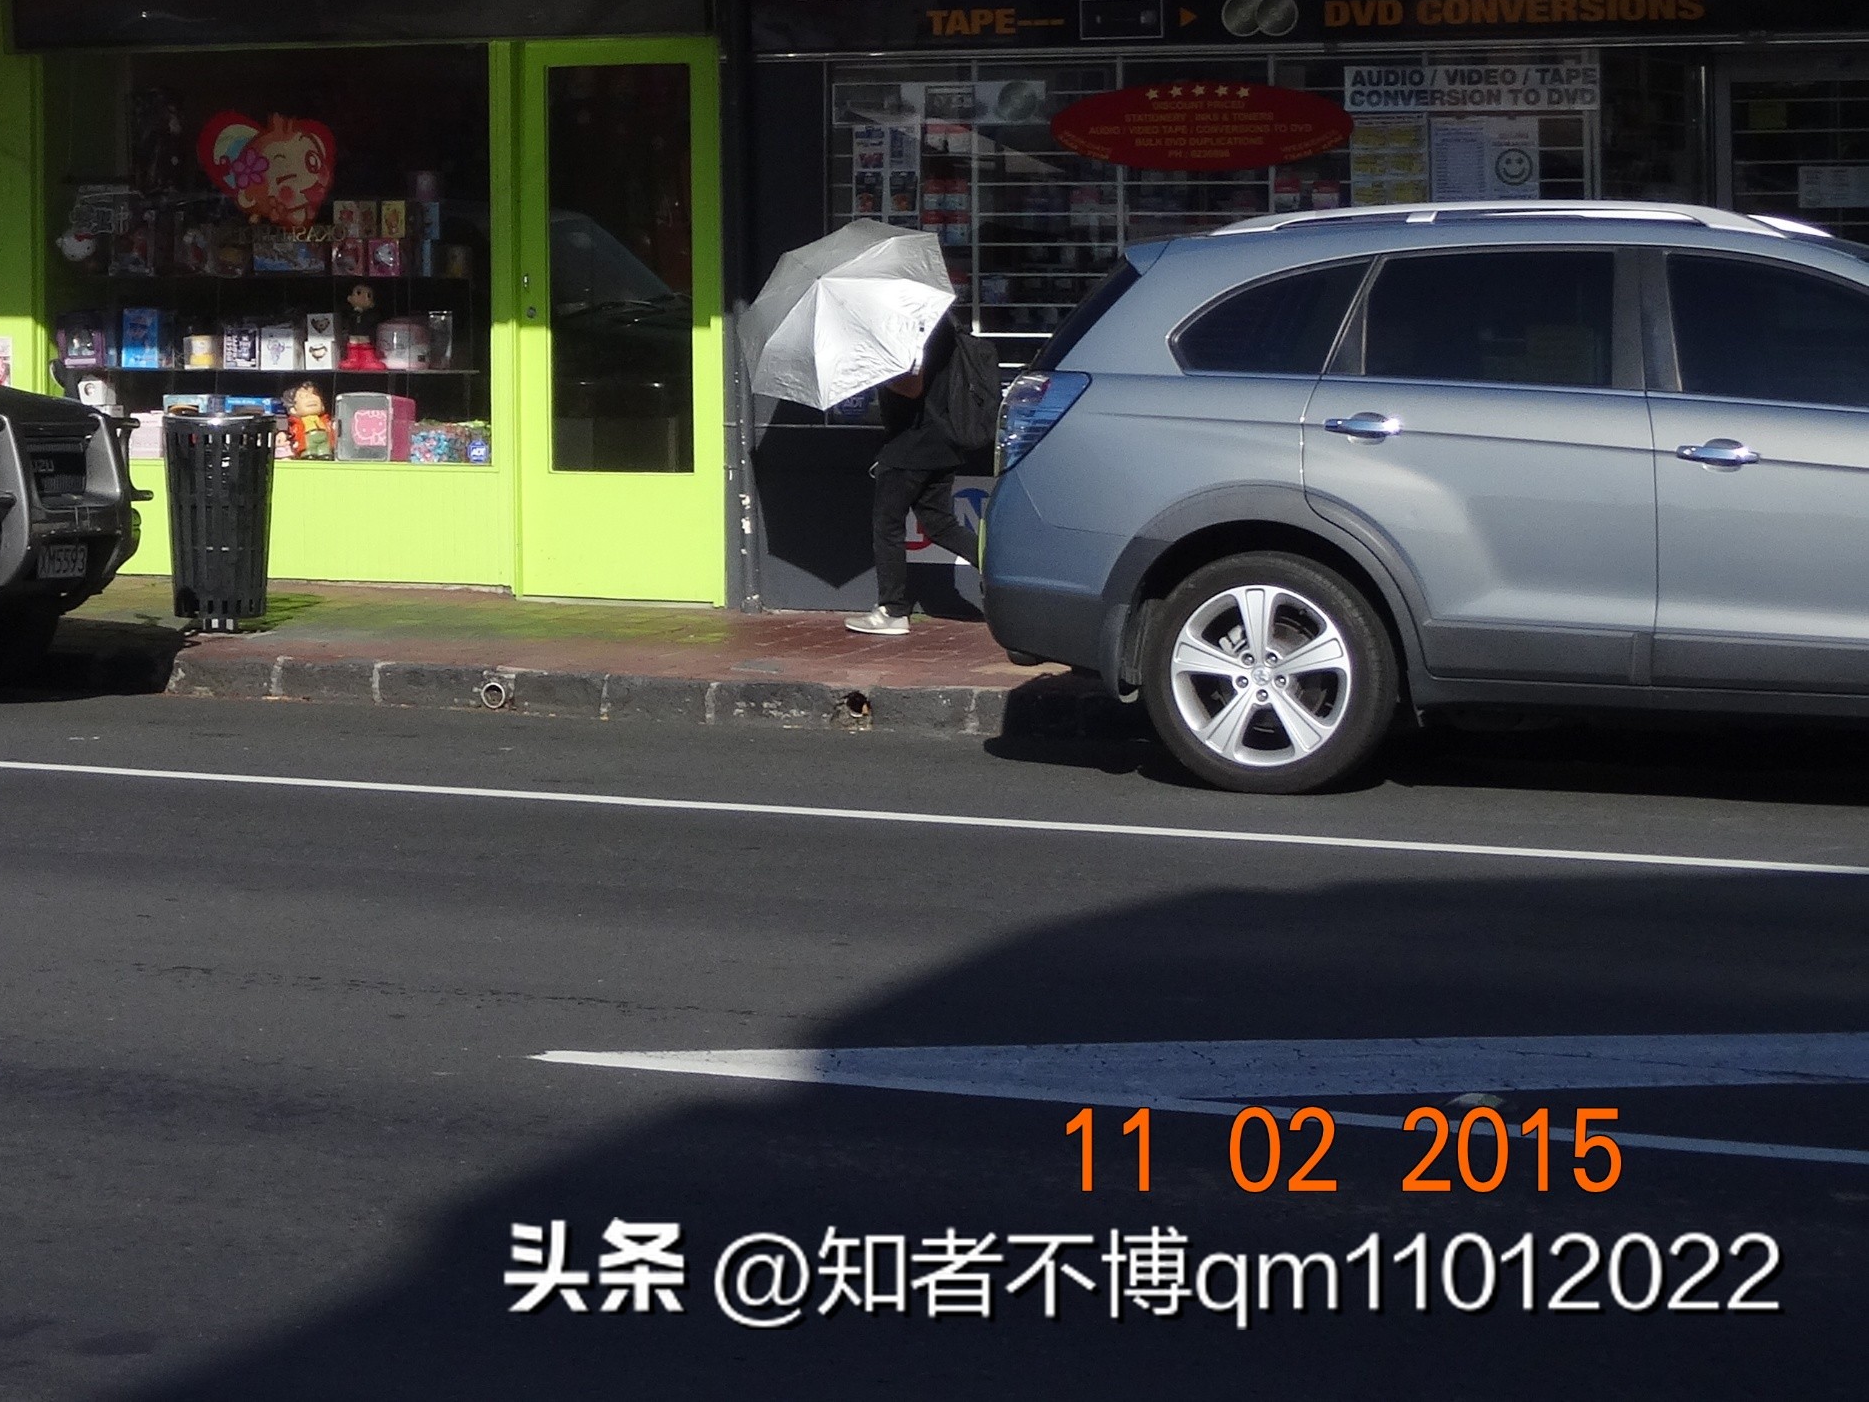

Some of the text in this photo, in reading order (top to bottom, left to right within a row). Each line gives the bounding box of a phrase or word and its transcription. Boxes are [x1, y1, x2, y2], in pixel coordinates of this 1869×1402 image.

[1324, 0, 1404, 28] DVD
[1351, 68, 1425, 88] AUDIO
[1444, 68, 1517, 86] VIDEO
[1535, 67, 1597, 85] TAPE
[1349, 88, 1597, 107] CONVERSION TO DVD
